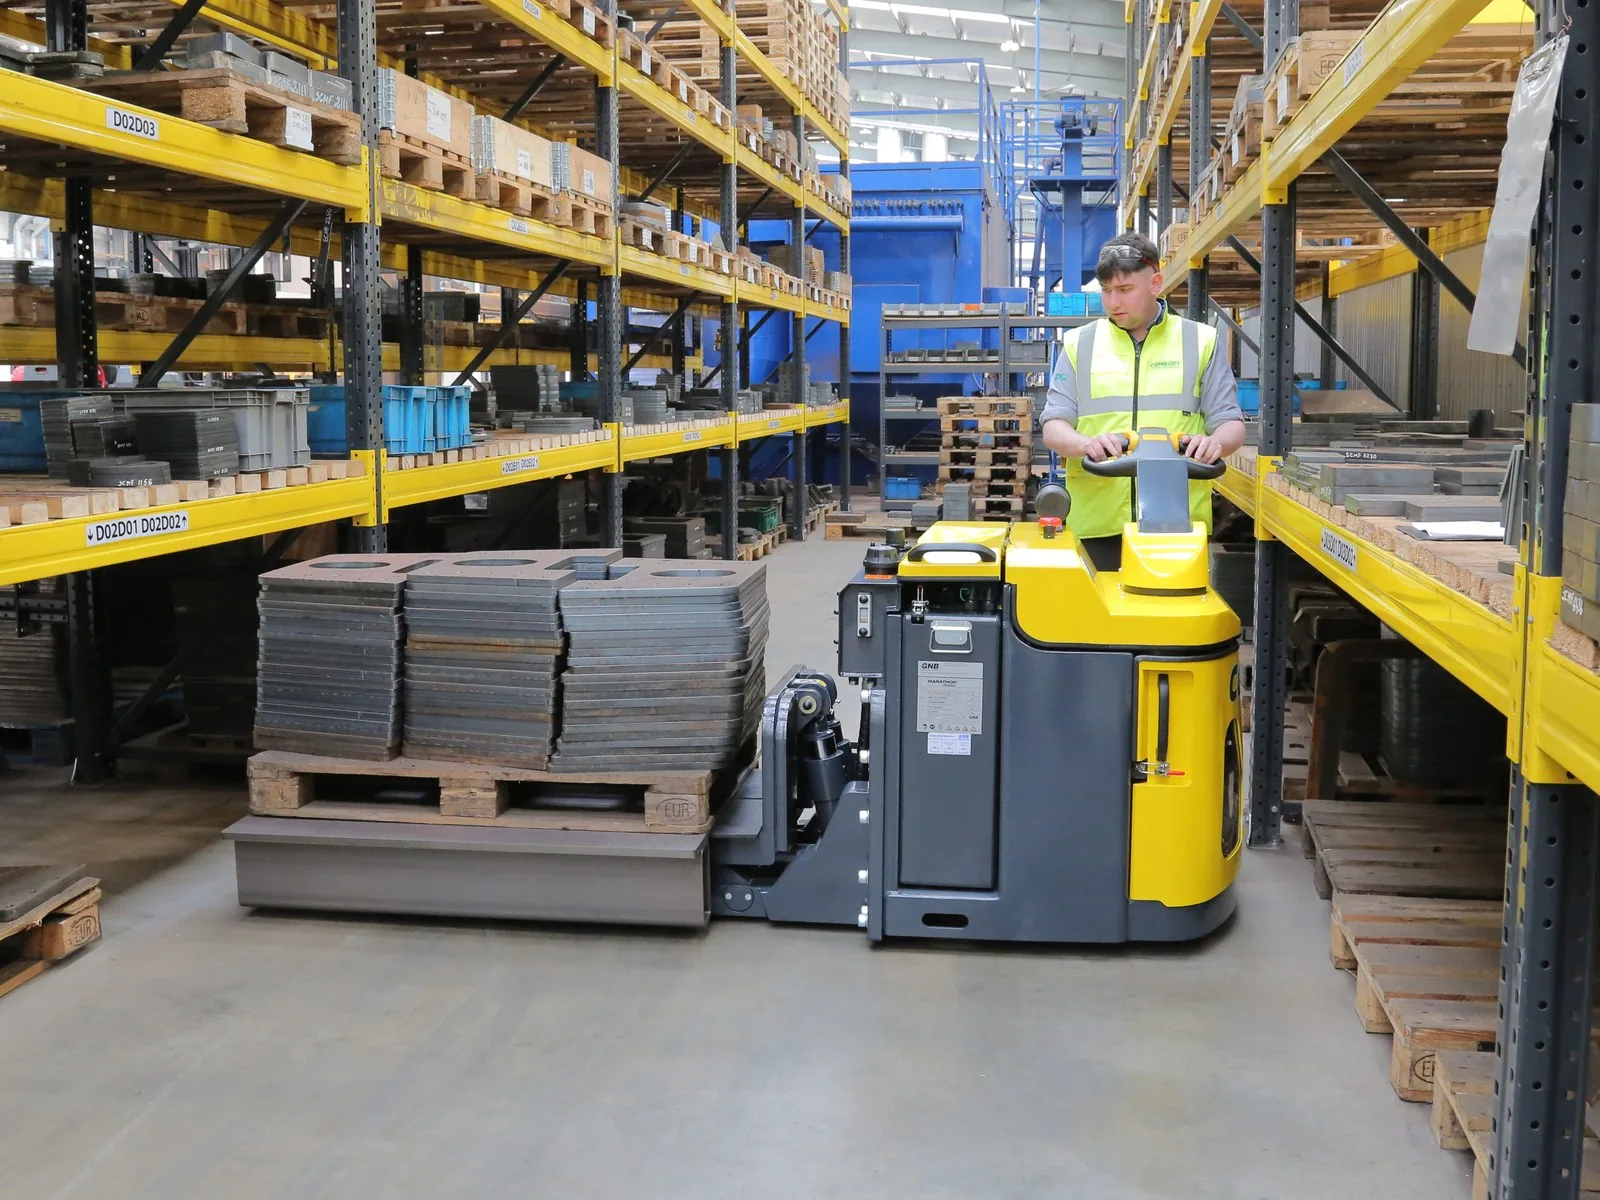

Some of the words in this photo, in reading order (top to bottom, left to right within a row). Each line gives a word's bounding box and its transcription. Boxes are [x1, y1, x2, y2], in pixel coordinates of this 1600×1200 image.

[113, 110, 156, 137] D02D03
[96, 519, 138, 541] D02D01
[141, 514, 181, 533] D02D02
[921, 662, 940, 670] GNB
[664, 802, 690, 818] EUR
[75, 919, 92, 943] EUR
